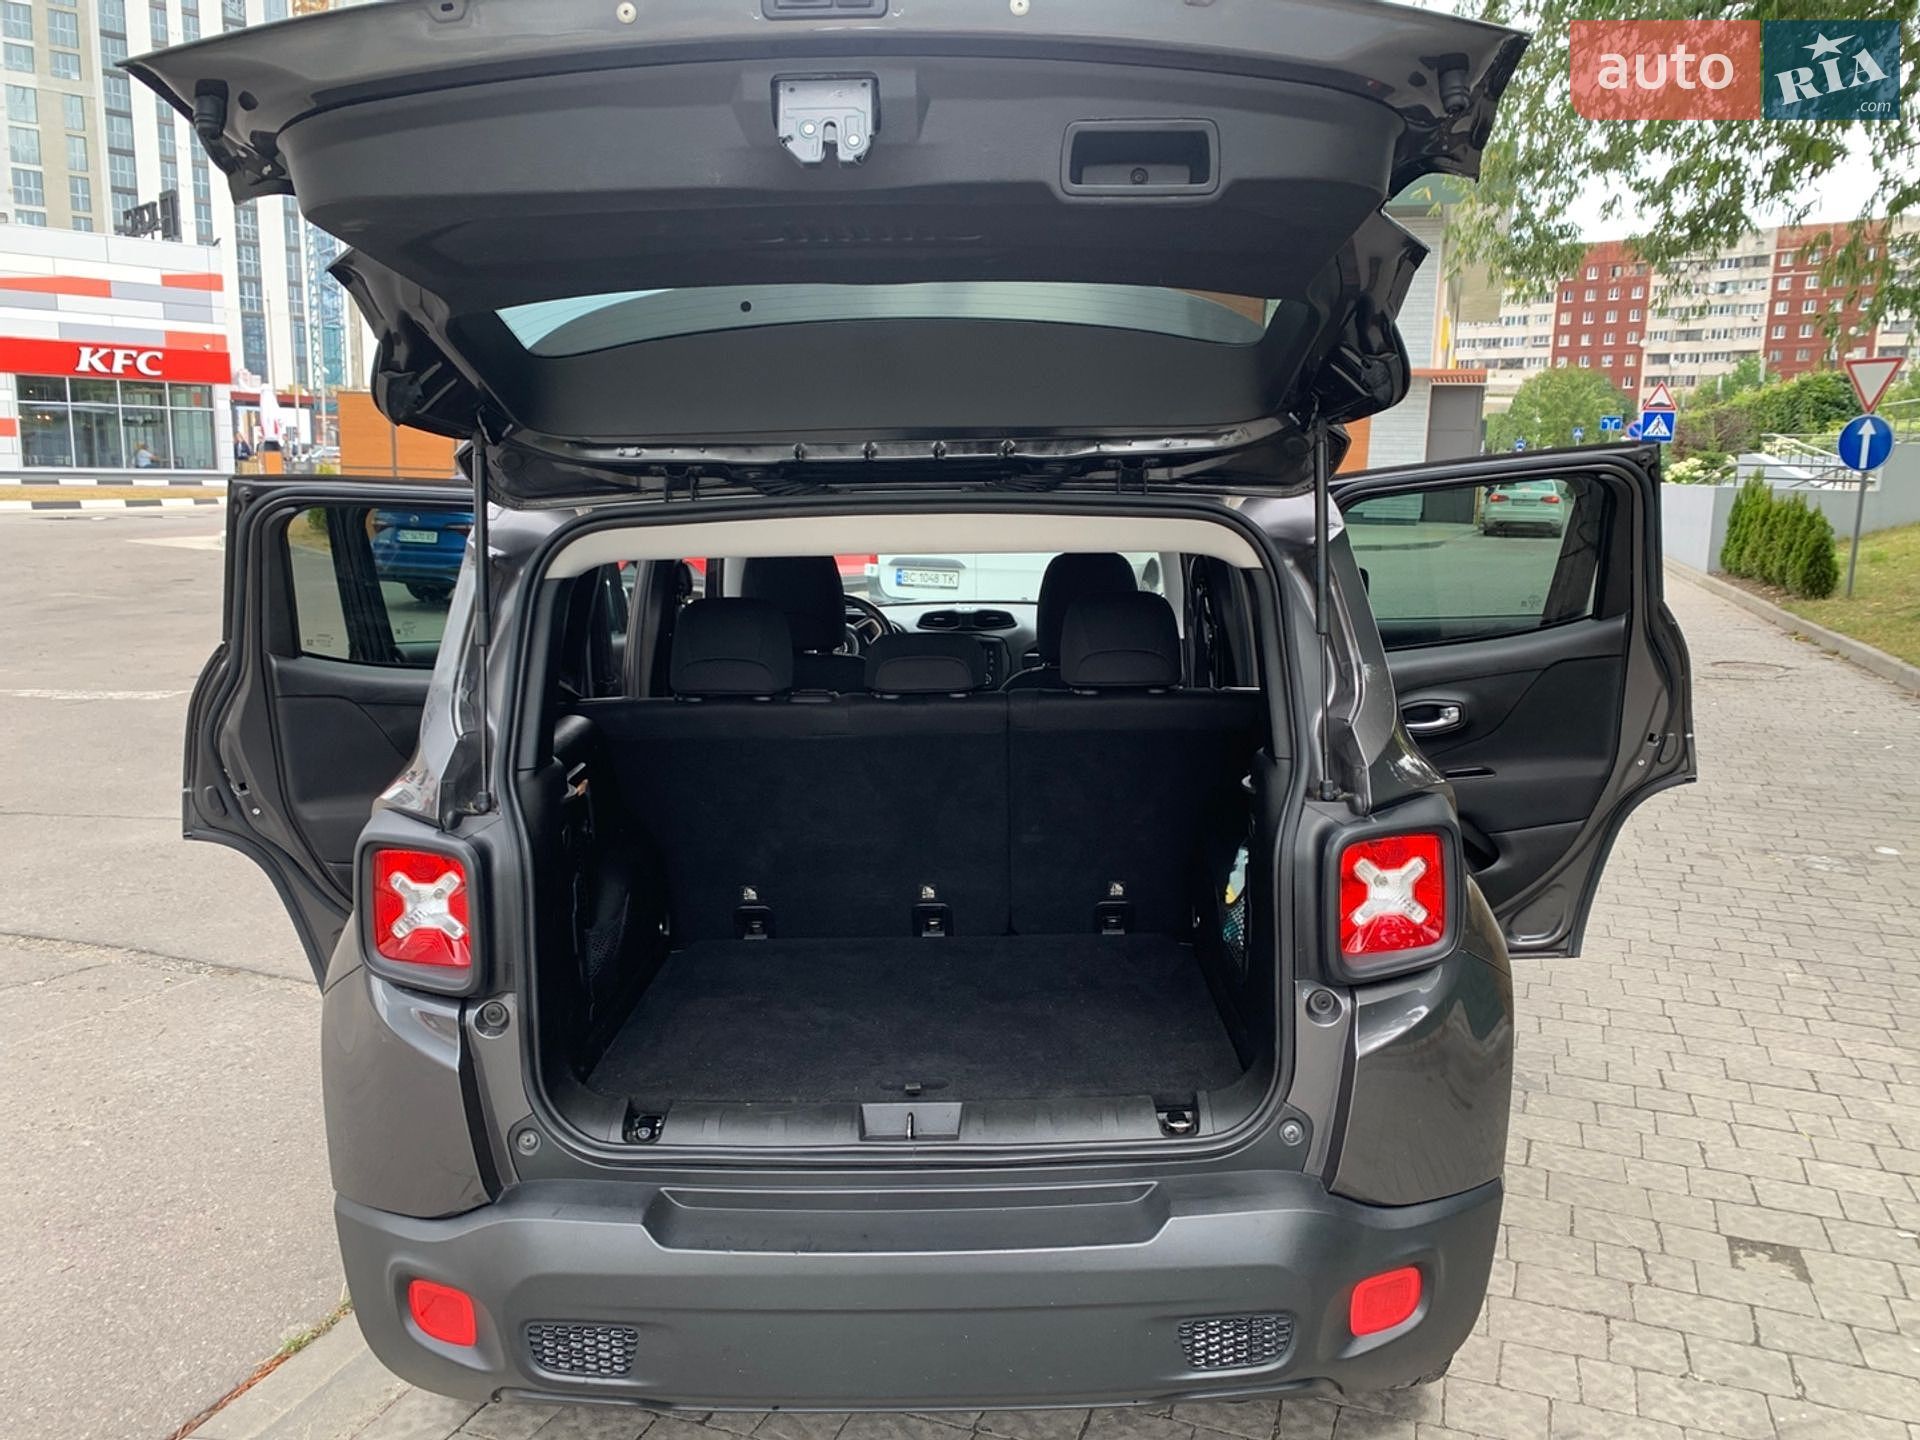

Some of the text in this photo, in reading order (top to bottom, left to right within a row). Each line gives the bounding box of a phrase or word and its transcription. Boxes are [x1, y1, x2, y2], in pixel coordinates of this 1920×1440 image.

[74, 346, 164, 377] KFC
[903, 571, 915, 583] BC
[943, 573, 956, 585] TK
